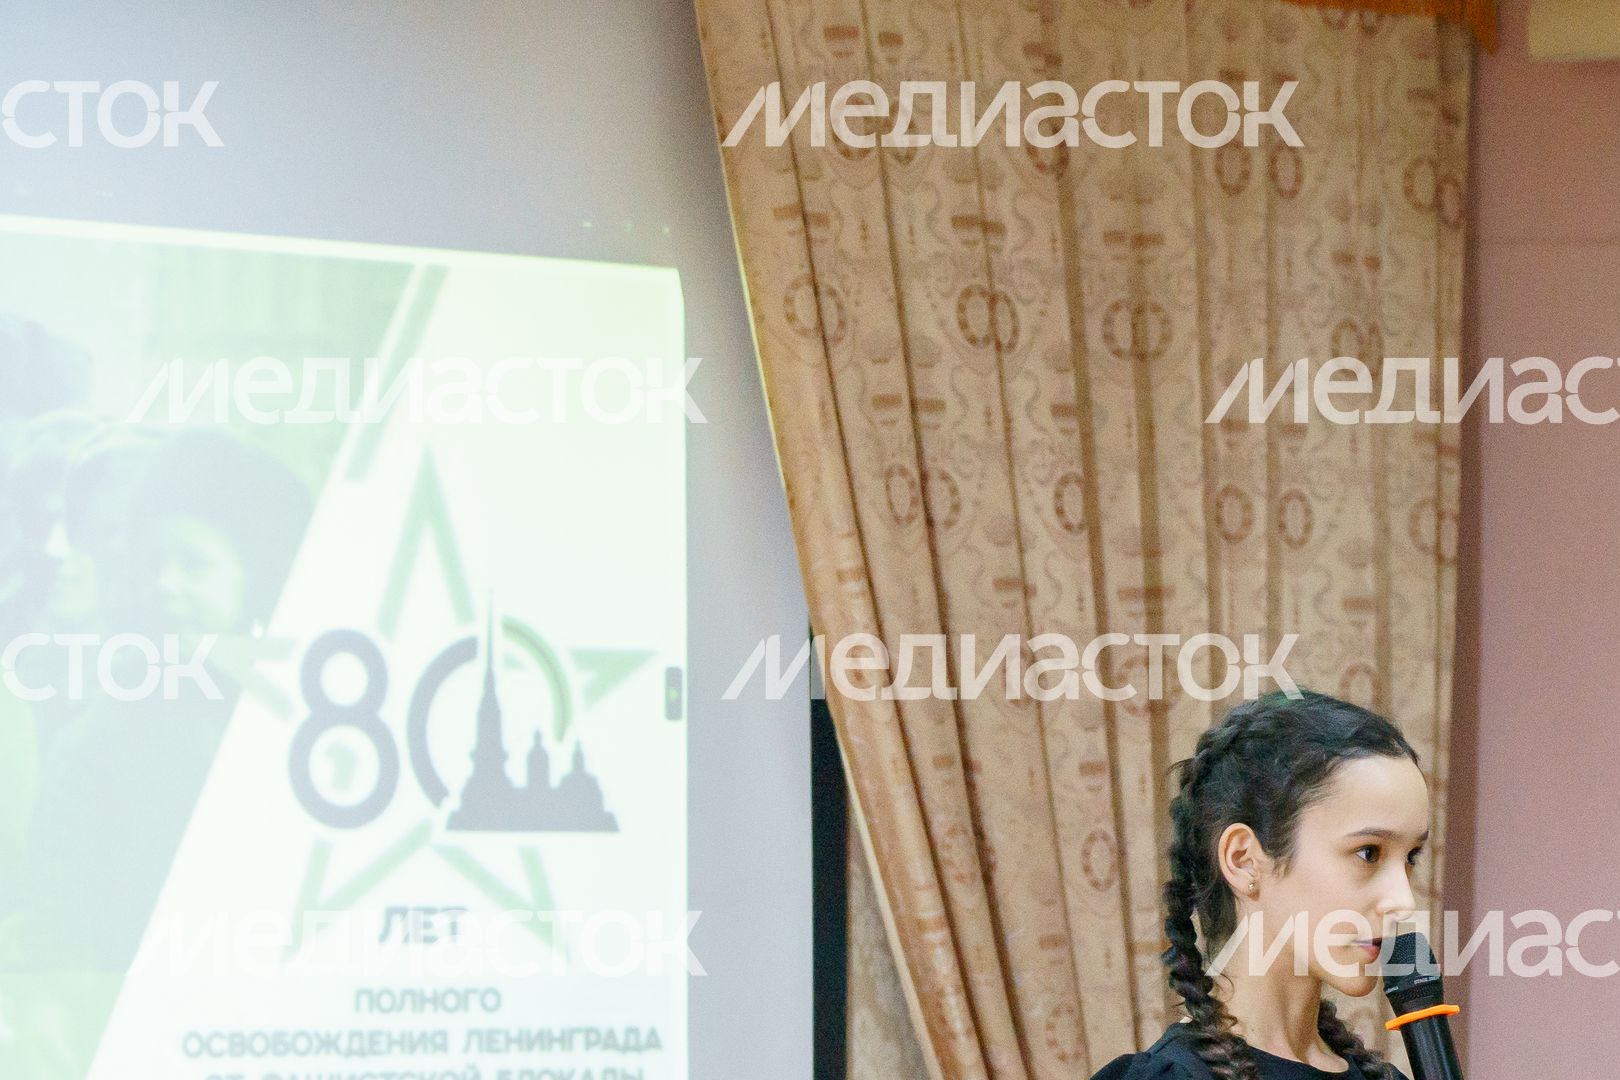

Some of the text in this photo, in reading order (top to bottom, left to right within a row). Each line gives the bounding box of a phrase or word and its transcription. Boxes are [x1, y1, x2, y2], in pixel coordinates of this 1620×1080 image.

[378, 905, 468, 944] ЛЕТ
[354, 987, 502, 1015] ПОЛНОГО
[182, 1025, 663, 1059] ОСВОБОЖДЕНИЯ ЛЕНИНГРАДА
